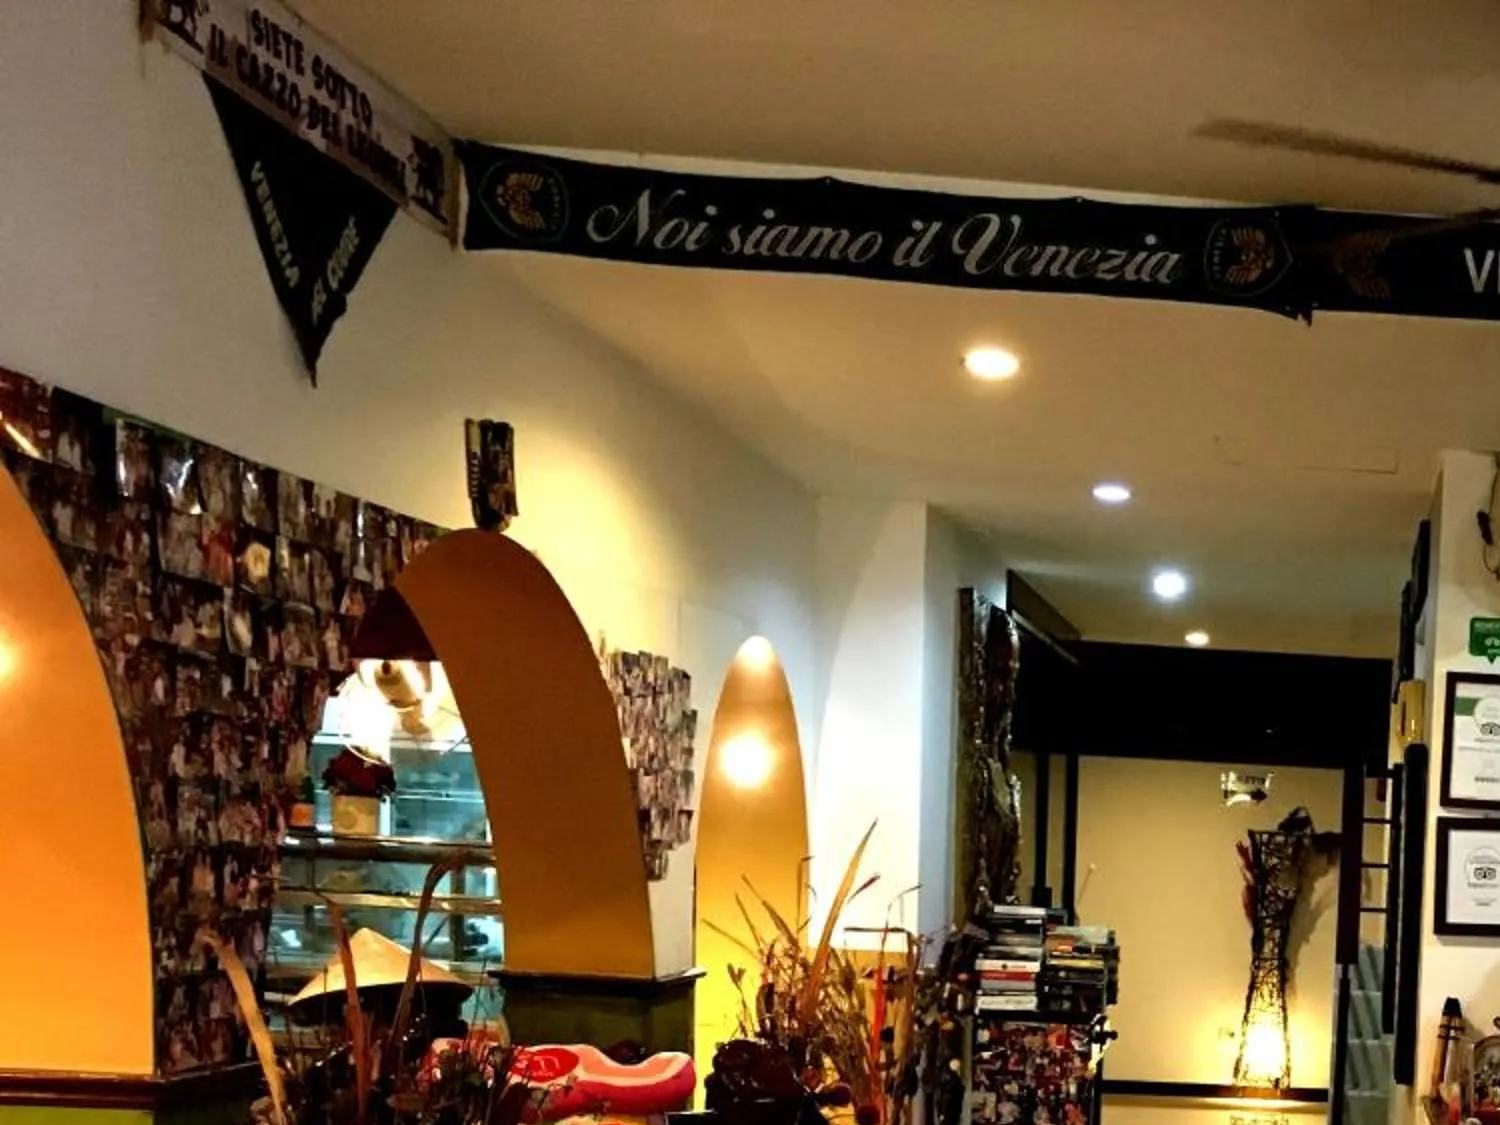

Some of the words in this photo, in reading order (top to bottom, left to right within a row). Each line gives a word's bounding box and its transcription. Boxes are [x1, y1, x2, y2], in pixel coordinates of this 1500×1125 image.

[251, 9, 305, 76] SIETE
[312, 55, 374, 126] SOTTO
[588, 186, 716, 252] Noi
[730, 205, 876, 266] siamo
[892, 217, 937, 269] il
[950, 212, 1184, 286] Venezia
